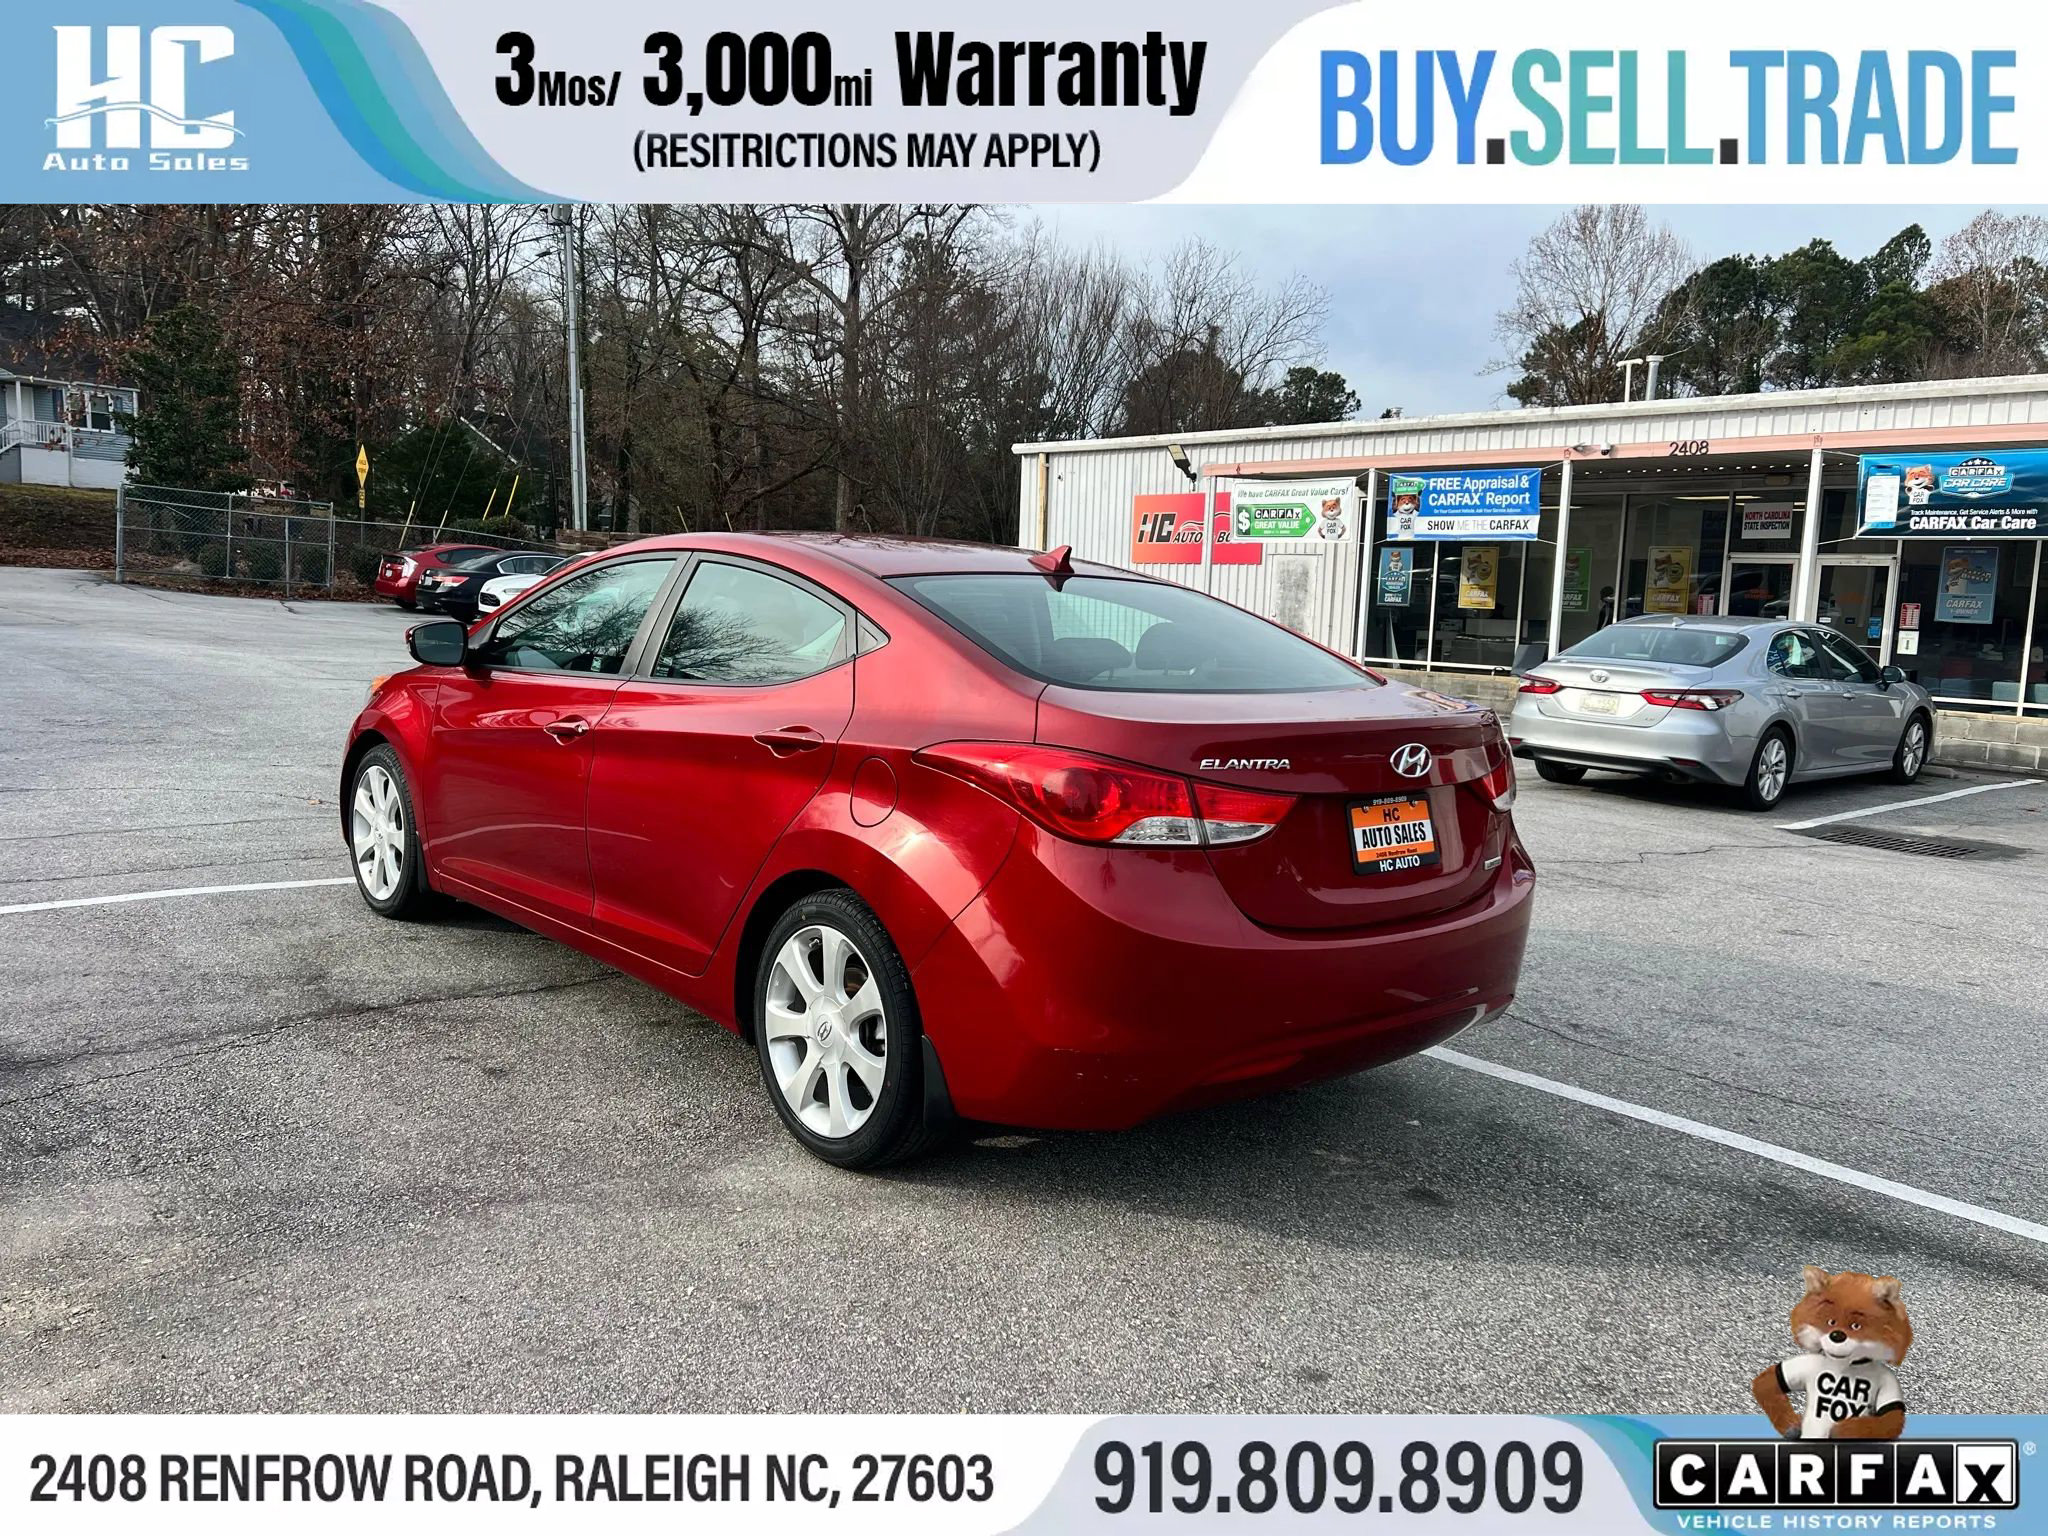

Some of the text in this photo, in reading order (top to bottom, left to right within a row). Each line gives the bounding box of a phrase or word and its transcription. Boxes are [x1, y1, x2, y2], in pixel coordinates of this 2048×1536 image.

[1669, 440, 1709, 456] 2408
[1950, 467, 2003, 476] CARFAX
[1429, 475, 1529, 493] FREE Appraisal &
[1943, 477, 2007, 487] CAR CARE
[1237, 487, 1349, 498] We have CARFAX Great Value Cars!
[1429, 492, 1530, 508] CARFAX Report
[1255, 509, 1301, 519] CARFAX
[1744, 511, 1791, 520] NORTH CAROLINA
[1138, 513, 1176, 542] HC
[1254, 520, 1300, 529] GREAT VALUE
[1427, 519, 1530, 531] SHOW ME THE CARFAX
[1744, 521, 1790, 530] STATE INSPECTION
[1909, 516, 2037, 530] CARFAX Car Care
[1173, 532, 1203, 543] AUTO
[1946, 600, 1983, 608] CARFAX
[1199, 758, 1291, 770] ELANTRA
[1383, 807, 1400, 822] HC
[1362, 822, 1426, 849] AUTO SALES
[1379, 855, 1420, 872] HC AUTO
